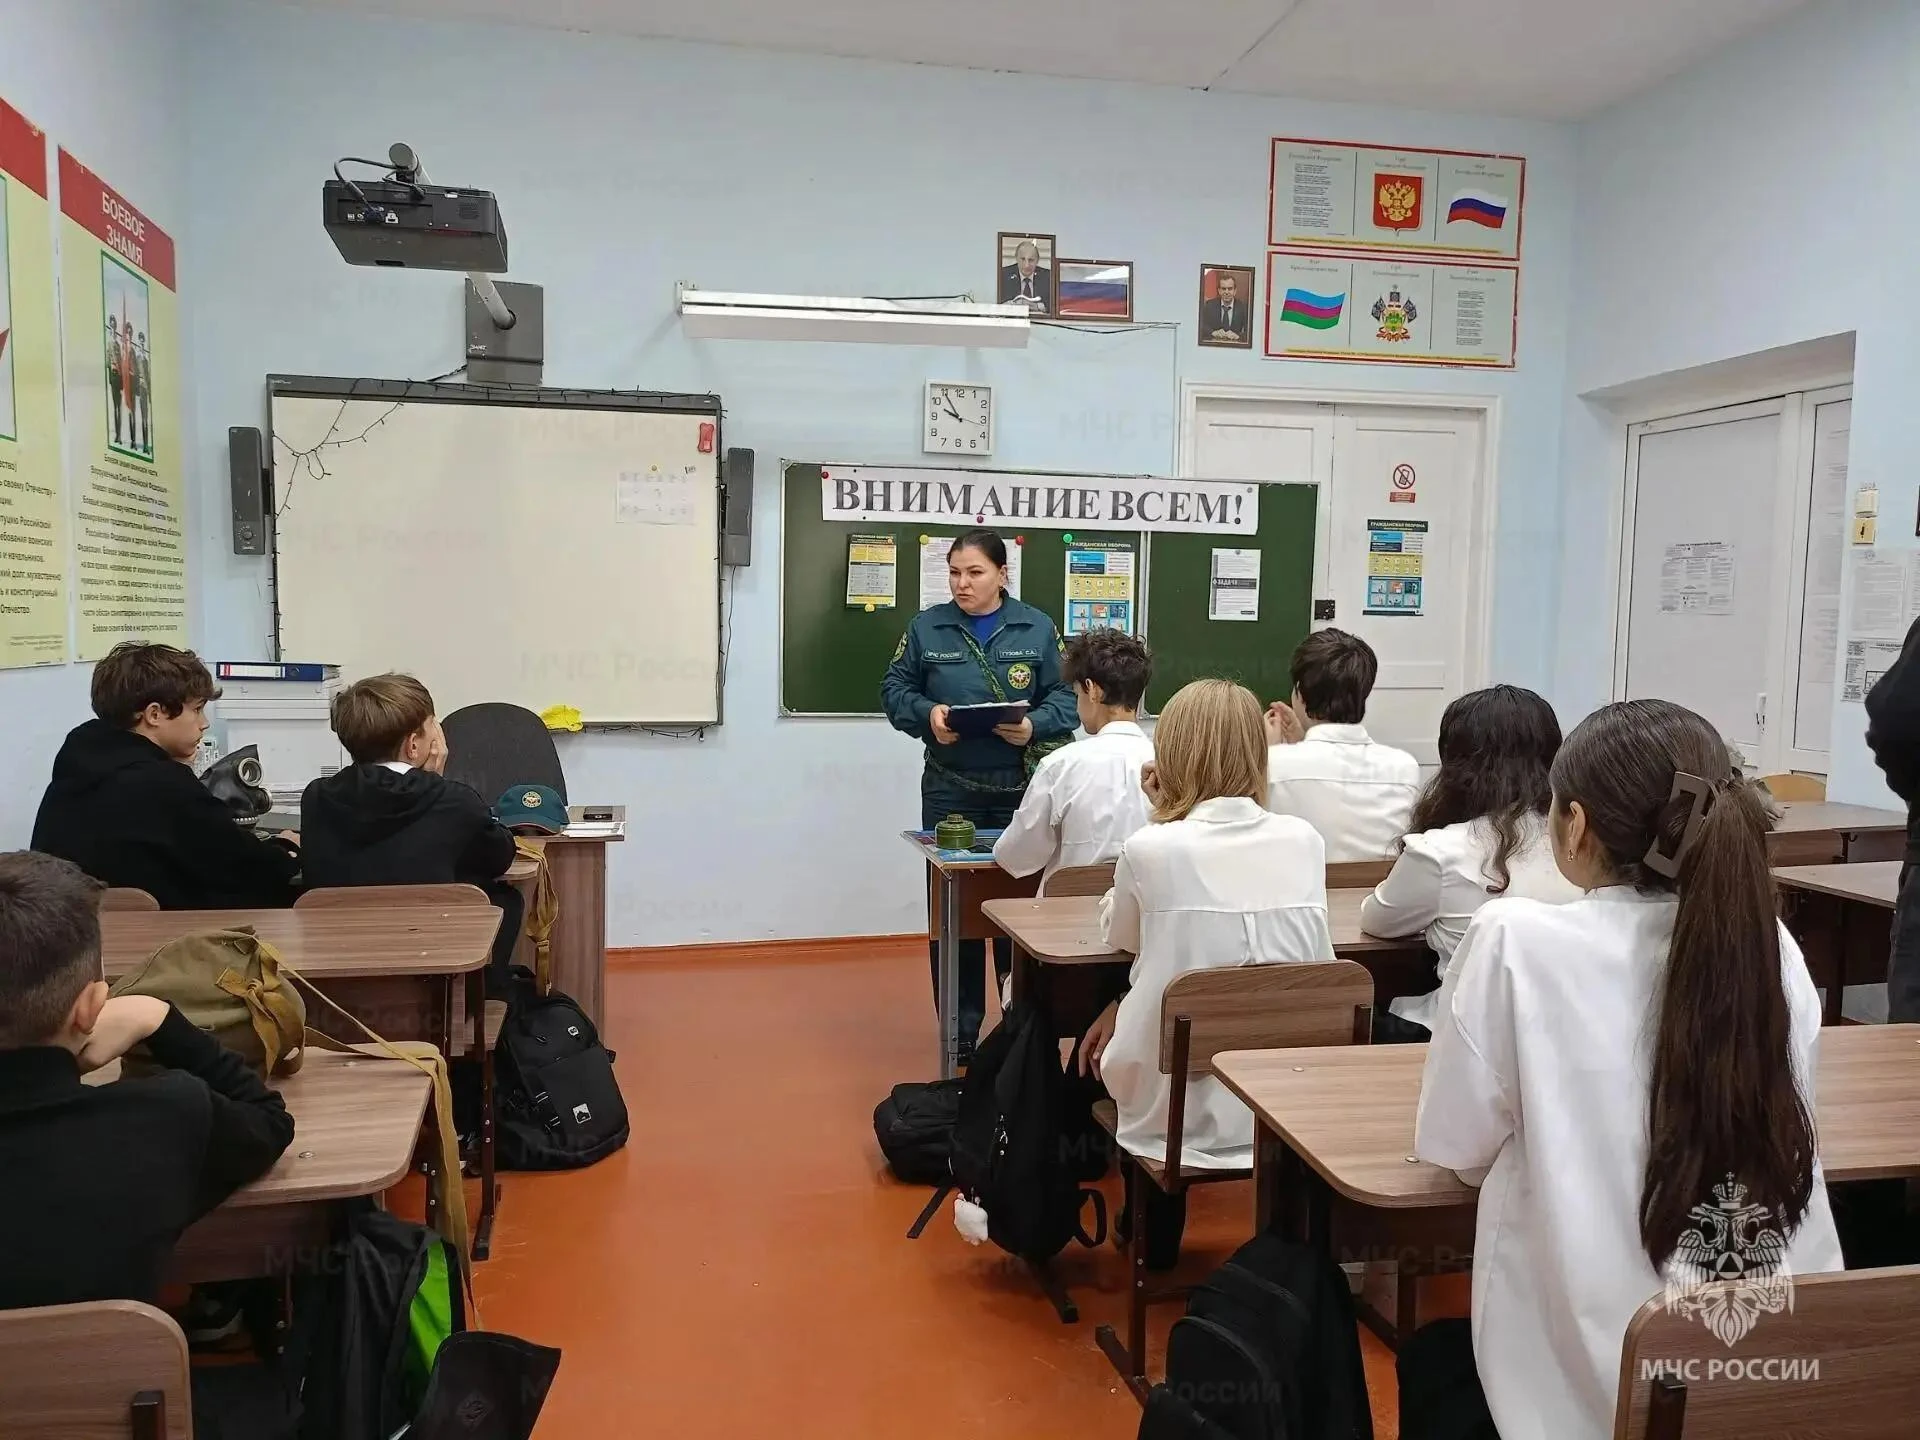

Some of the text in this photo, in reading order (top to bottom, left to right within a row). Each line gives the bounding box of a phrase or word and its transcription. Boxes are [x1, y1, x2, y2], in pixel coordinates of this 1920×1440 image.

[102, 191, 145, 242] БОЕВОЕ
[106, 224, 143, 267] ЗНАМЯ
[955, 388, 965, 398] 12
[972, 389, 976, 399] 1
[932, 396, 941, 406] 10
[980, 400, 987, 409] 2
[931, 412, 938, 421] 9
[980, 415, 987, 424] 3
[930, 428, 938, 437] 8
[979, 431, 986, 440] 4
[940, 438, 947, 449] 7
[954, 438, 962, 448] 6
[969, 439, 977, 449] 5
[832, 478, 1243, 525] ВНИМАНИЕ ВСЕМ!
